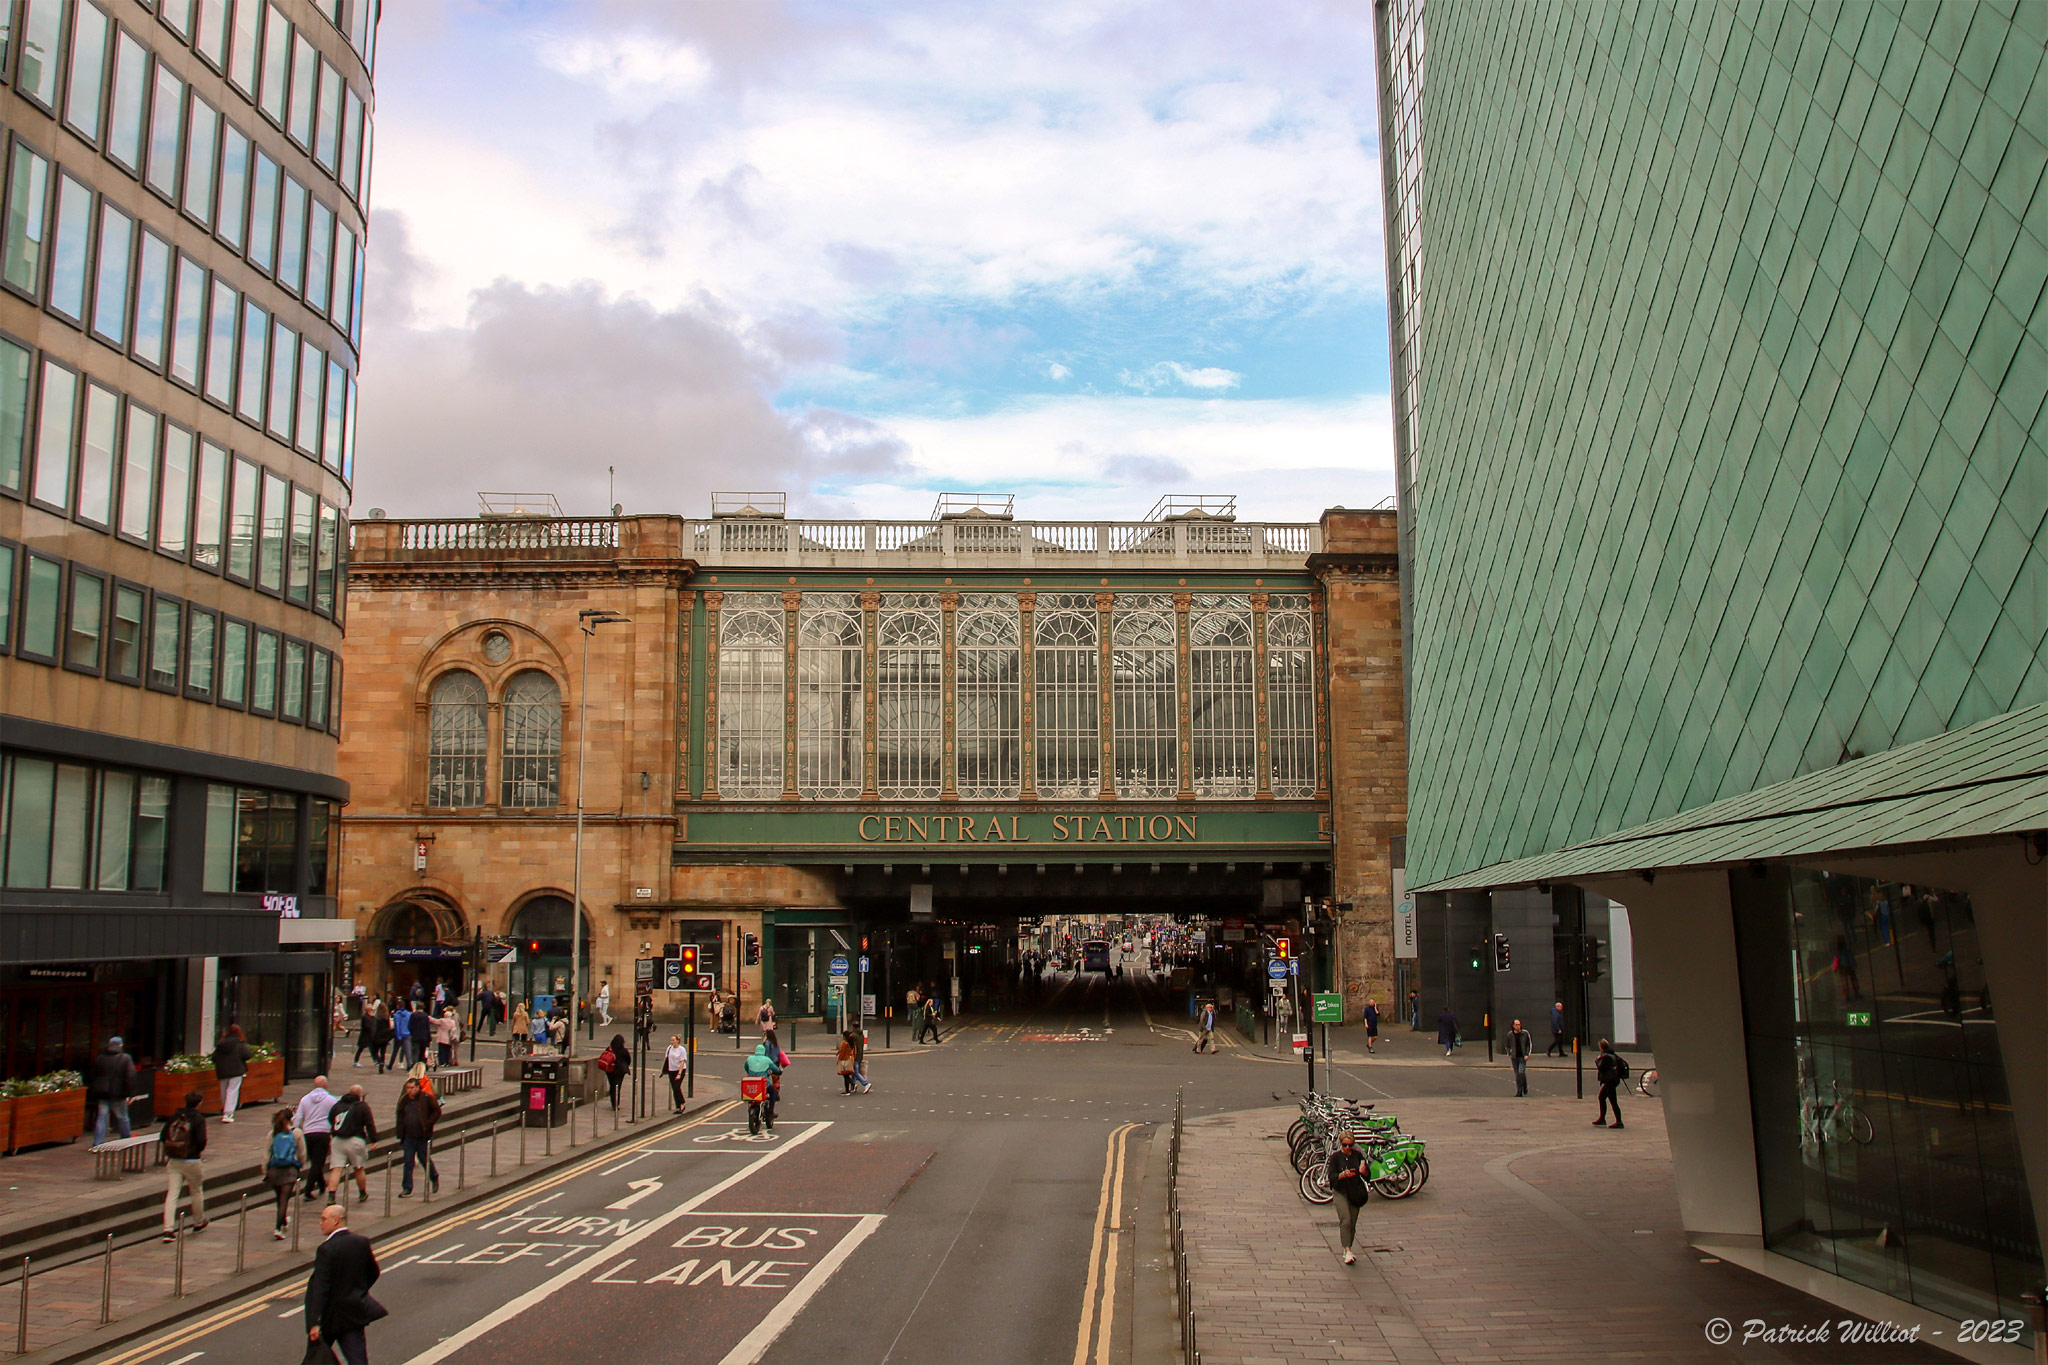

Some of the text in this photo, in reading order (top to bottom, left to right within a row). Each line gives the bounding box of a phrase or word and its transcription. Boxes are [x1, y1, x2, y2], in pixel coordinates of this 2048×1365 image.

[858, 814, 1198, 842] CENTRAL STATION
[389, 948, 411, 956] Glasgow
[30, 969, 87, 978] Wetherspoon
[497, 1216, 650, 1236] TURN
[671, 1226, 818, 1250] BUS
[417, 1242, 602, 1267] LEFT
[591, 1258, 809, 1288] LANE
